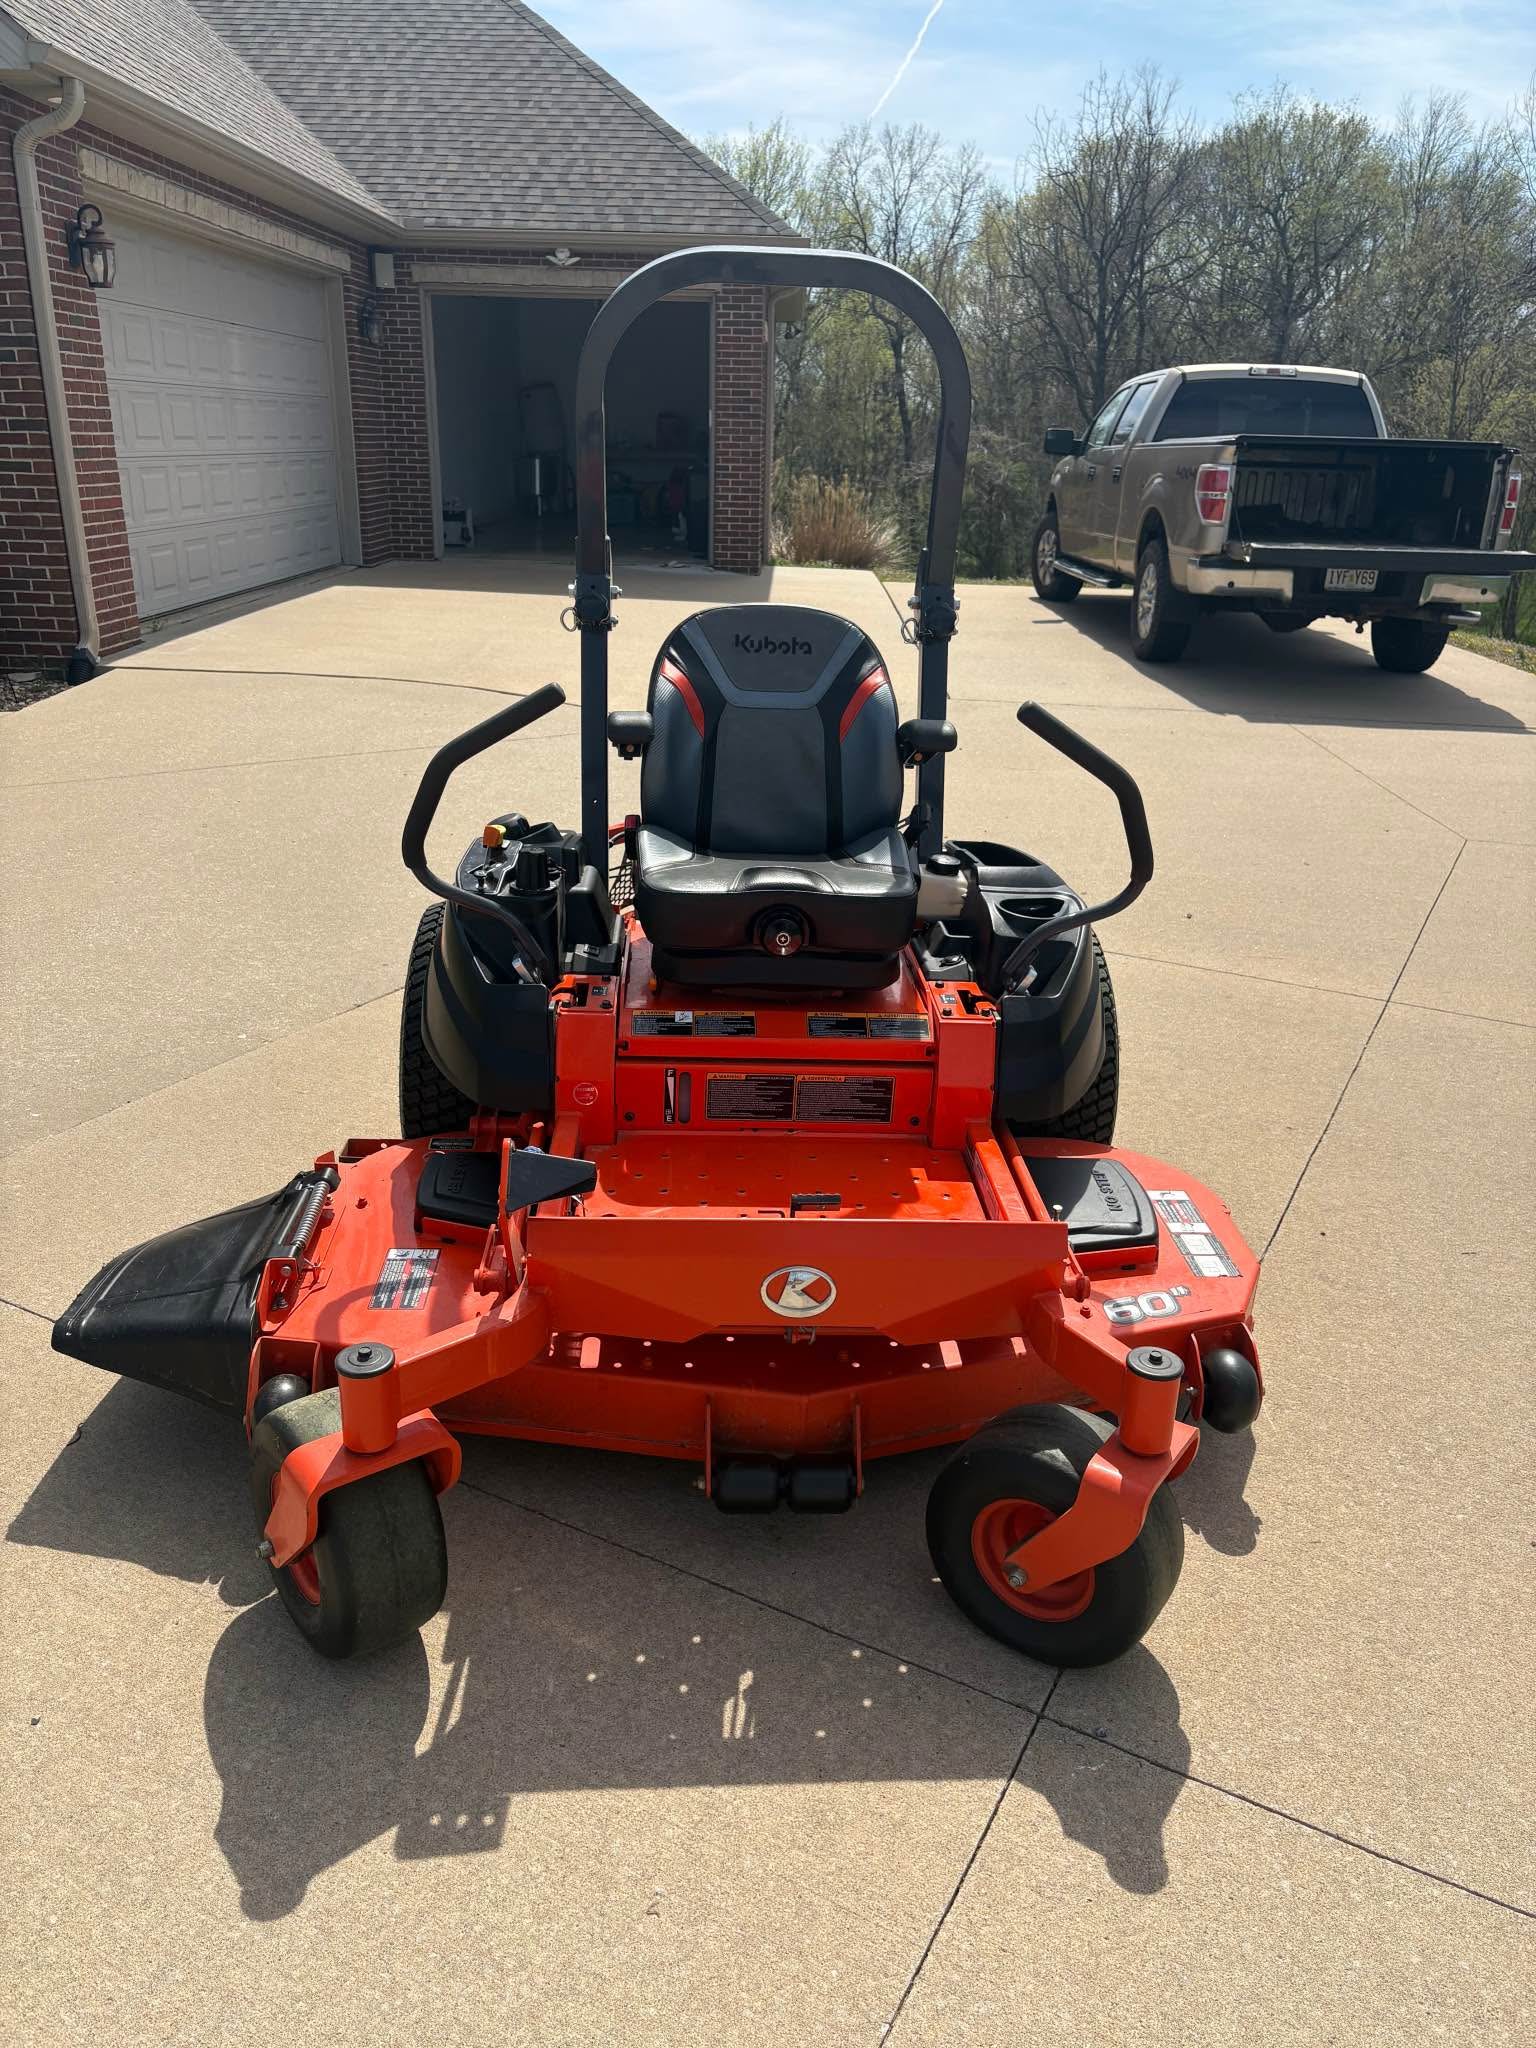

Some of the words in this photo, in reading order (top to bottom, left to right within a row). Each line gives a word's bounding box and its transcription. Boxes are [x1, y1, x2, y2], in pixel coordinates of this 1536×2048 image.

[735, 634, 812, 655] Kubota
[667, 1069, 674, 1077] F
[666, 1114, 673, 1122] E
[1091, 1170, 1113, 1194] STEP
[1105, 1196, 1123, 1212] NO
